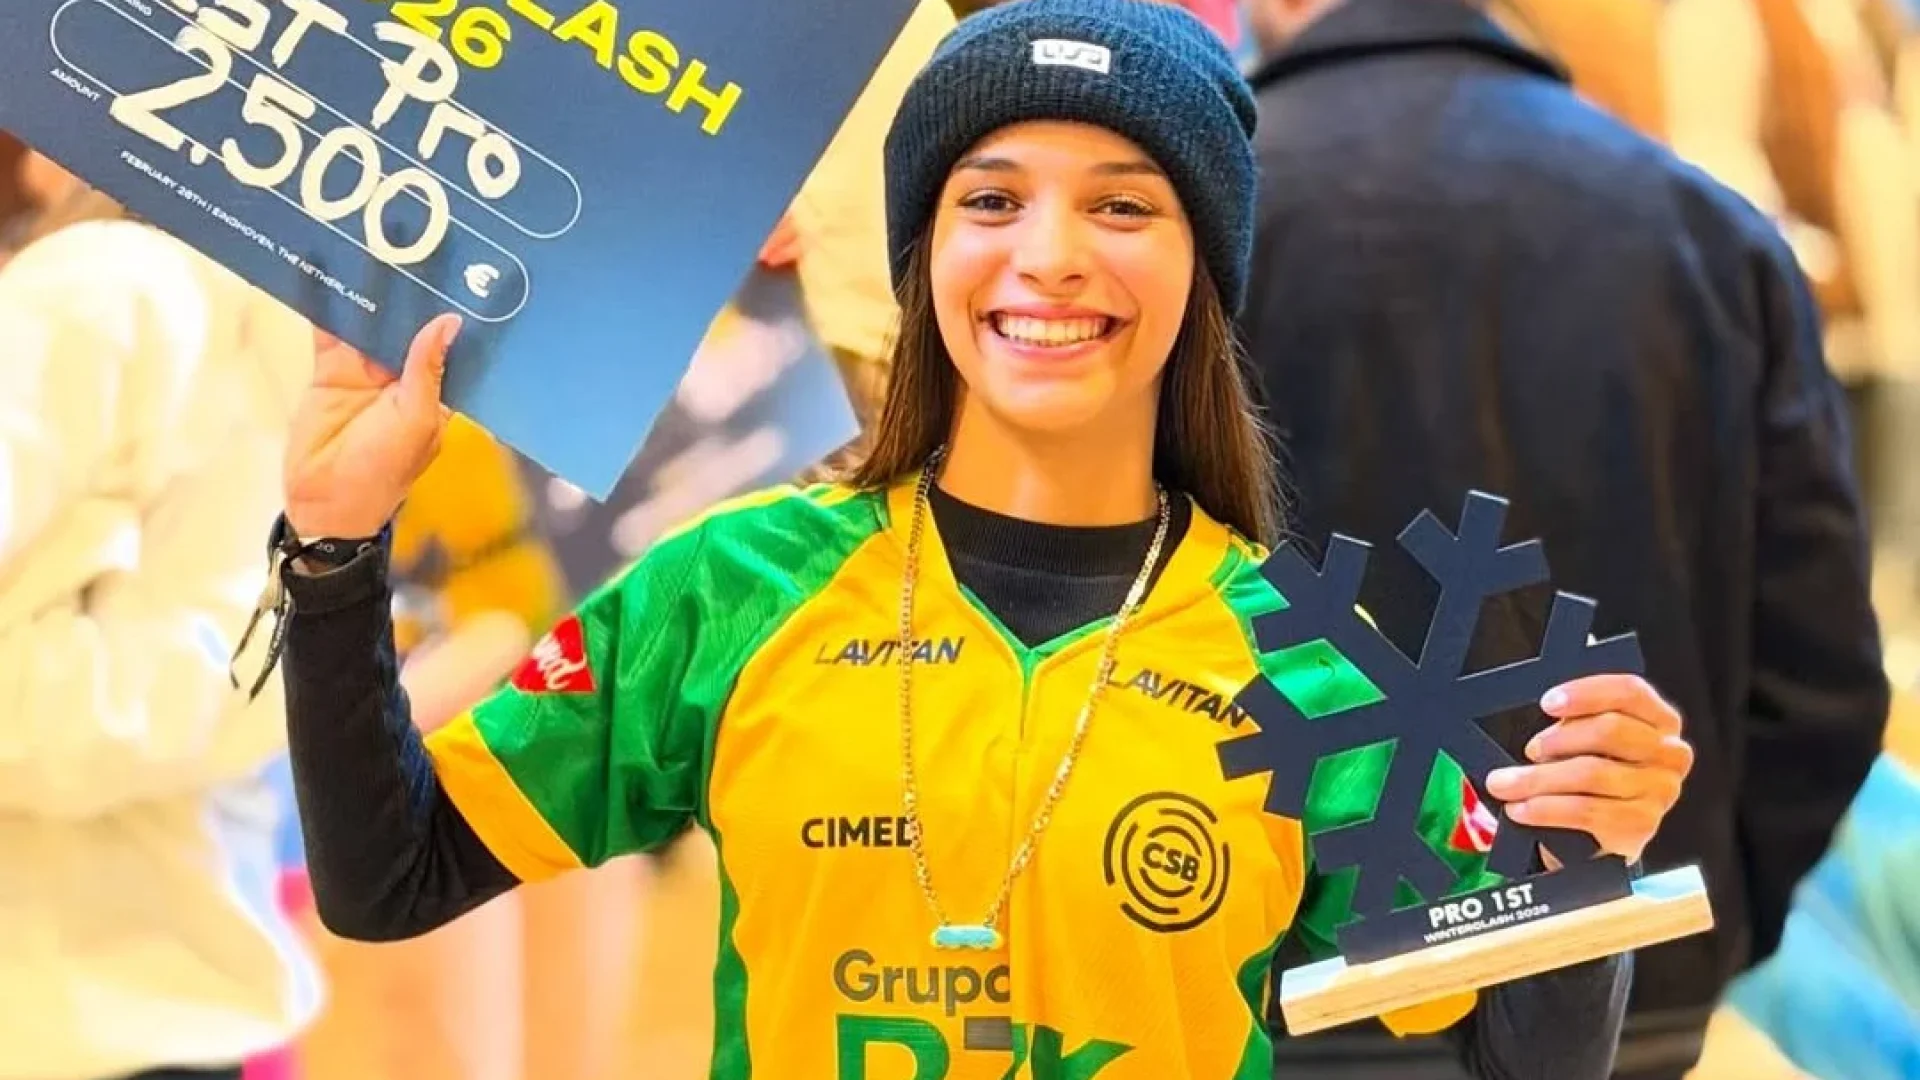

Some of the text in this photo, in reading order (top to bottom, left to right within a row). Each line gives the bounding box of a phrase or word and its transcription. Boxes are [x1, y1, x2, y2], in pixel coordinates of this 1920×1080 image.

[50, 68, 100, 101] AMOUNT
[372, 21, 520, 199] Pro
[121, 150, 178, 188] FEBRUARY
[278, 245, 300, 266] THE
[299, 260, 376, 312] NETHERLANDS
[463, 264, 499, 298] €
[1106, 660, 1247, 728] LAVITAN
[1143, 841, 1199, 882] CSB
[1428, 882, 1533, 928] PRO 1ST
